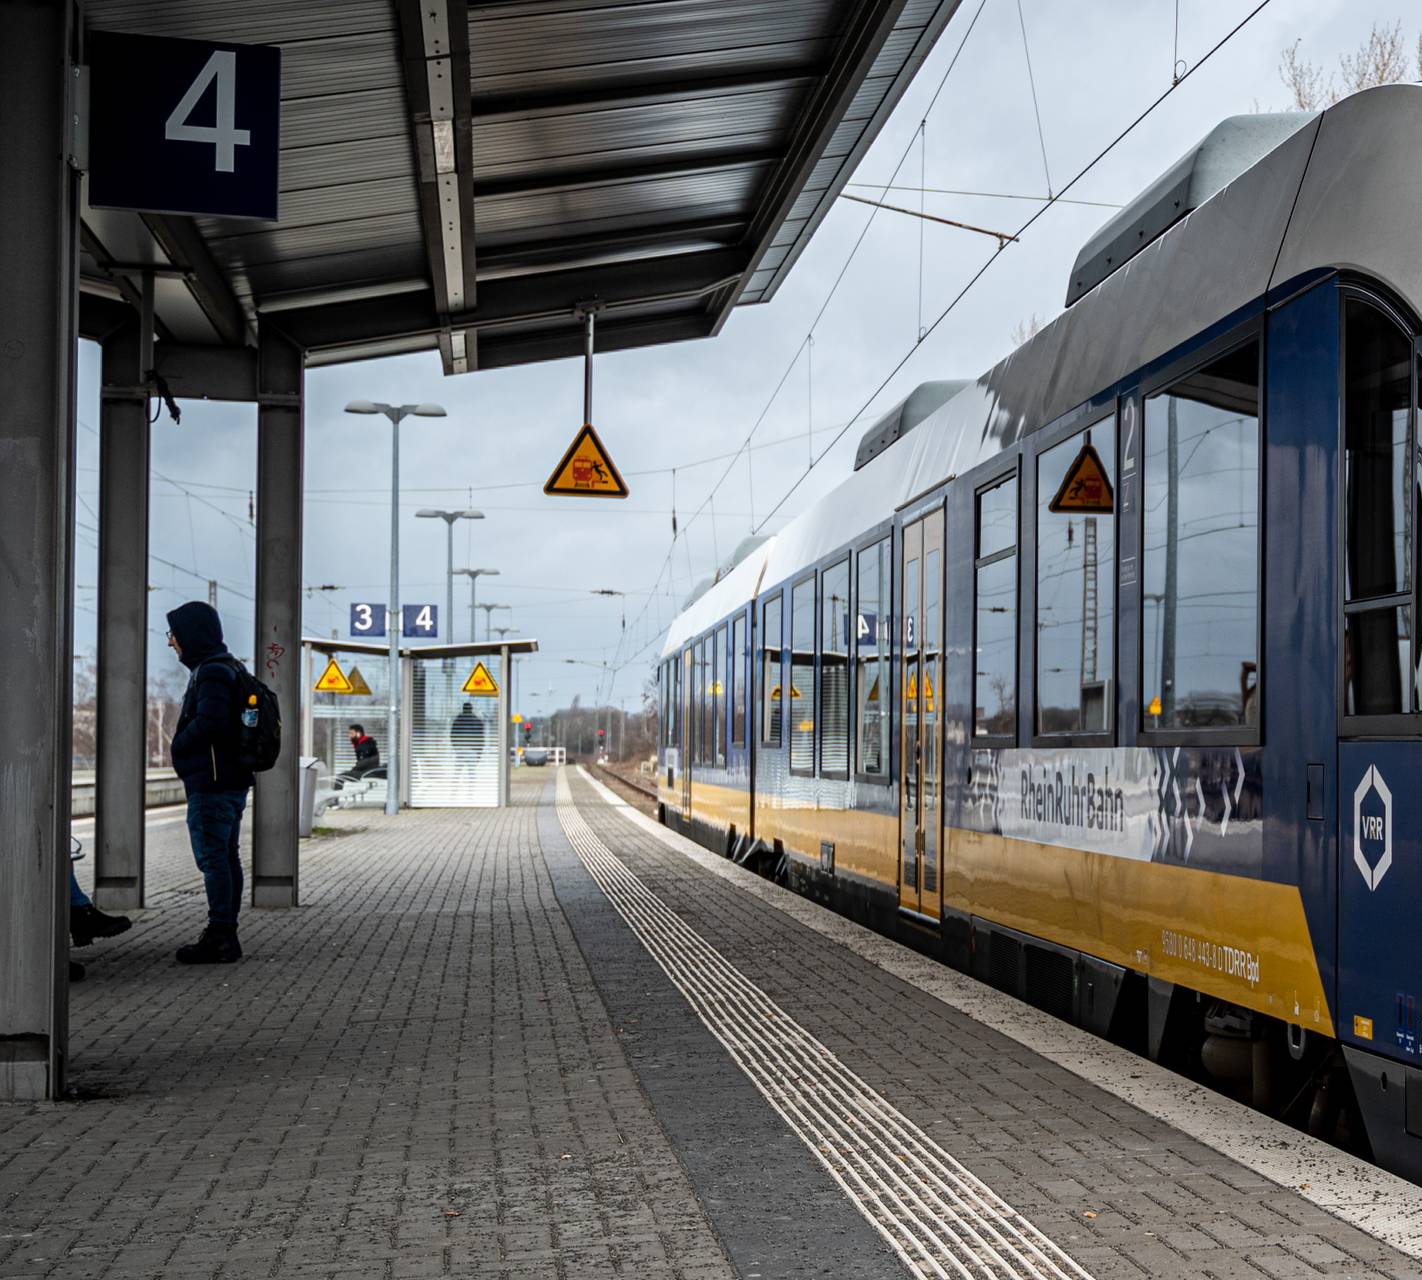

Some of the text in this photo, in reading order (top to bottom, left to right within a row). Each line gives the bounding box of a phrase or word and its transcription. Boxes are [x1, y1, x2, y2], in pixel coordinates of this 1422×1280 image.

[165, 50, 251, 173] 4
[1123, 397, 1136, 471] 2
[354, 603, 434, 631] 3 4
[1020, 763, 1125, 833] RheinRuhrBahn
[1362, 815, 1384, 841] VRR
